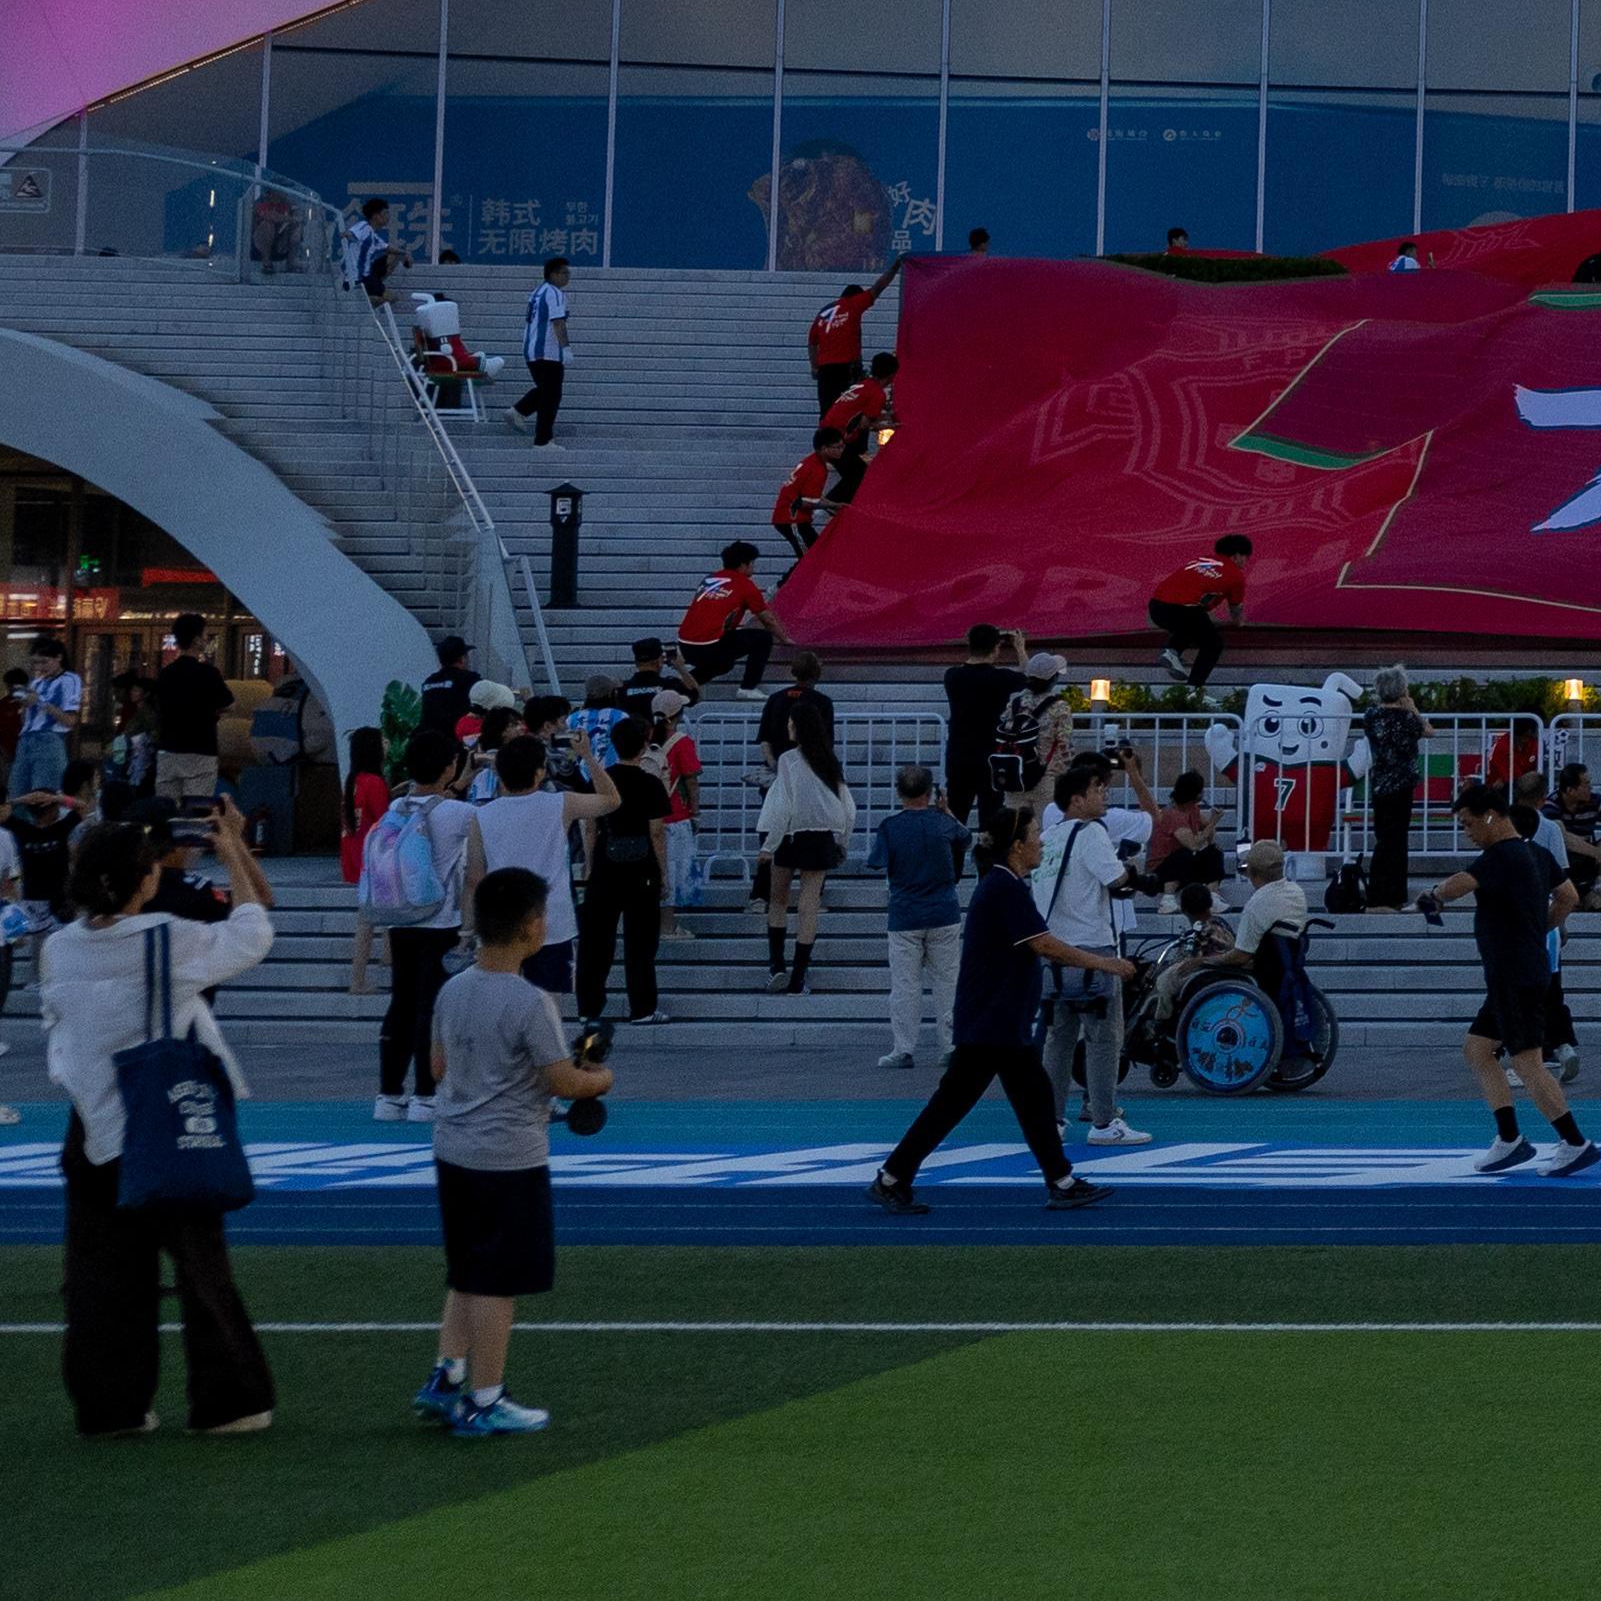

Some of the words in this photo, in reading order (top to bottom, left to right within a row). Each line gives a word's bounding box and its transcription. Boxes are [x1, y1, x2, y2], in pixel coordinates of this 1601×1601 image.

[482, 198, 541, 227] 韩式
[478, 228, 598, 256] 无限烤肉
[1273, 777, 1297, 812] 7
